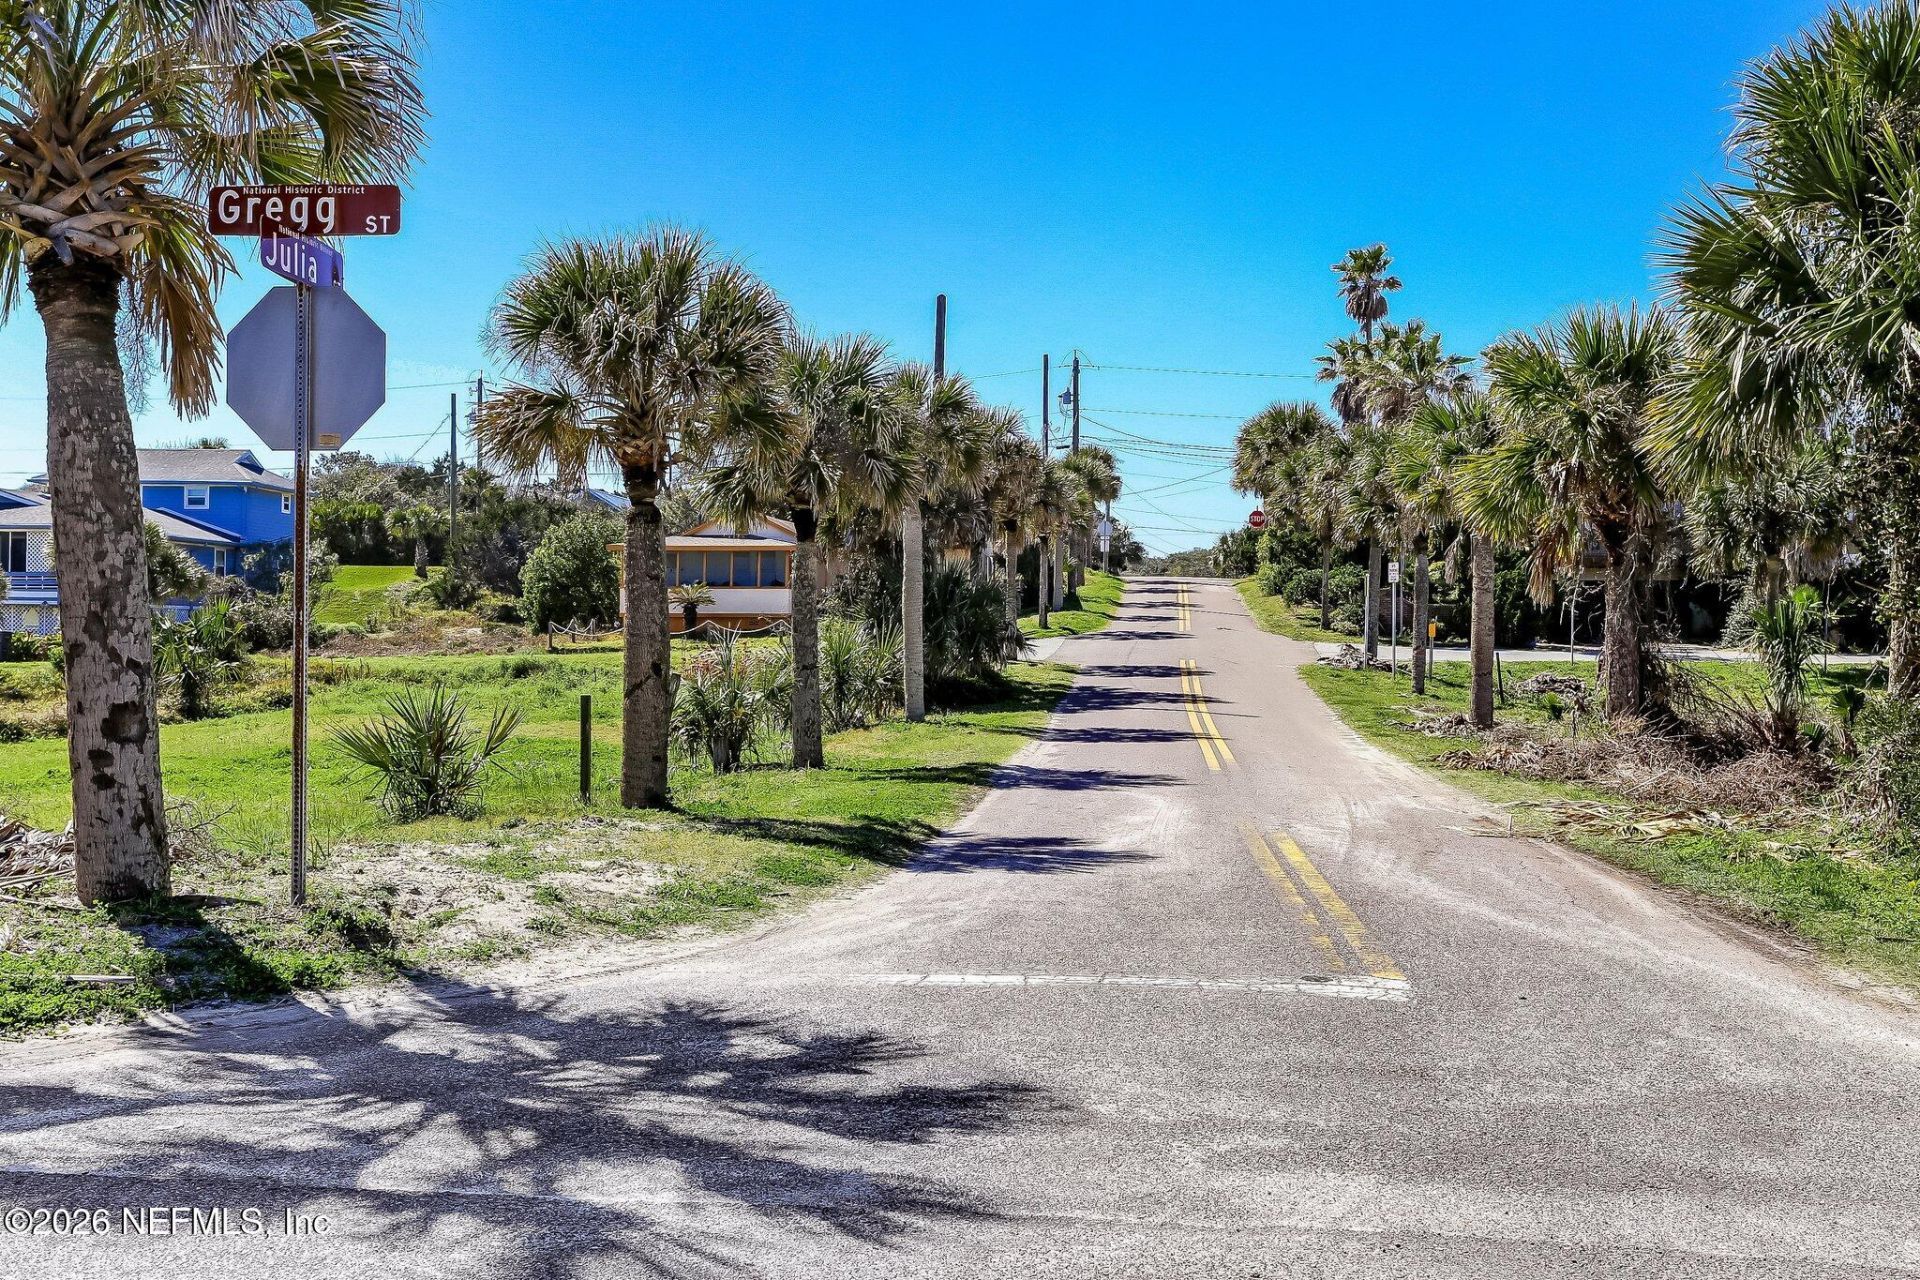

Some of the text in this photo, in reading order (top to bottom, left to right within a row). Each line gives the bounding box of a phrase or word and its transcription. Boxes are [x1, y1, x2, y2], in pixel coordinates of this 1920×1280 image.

[243, 185, 365, 195] National Historic District
[218, 189, 391, 234] Gregg ST
[266, 231, 317, 284] Julia
[1251, 515, 1265, 523] STOP
